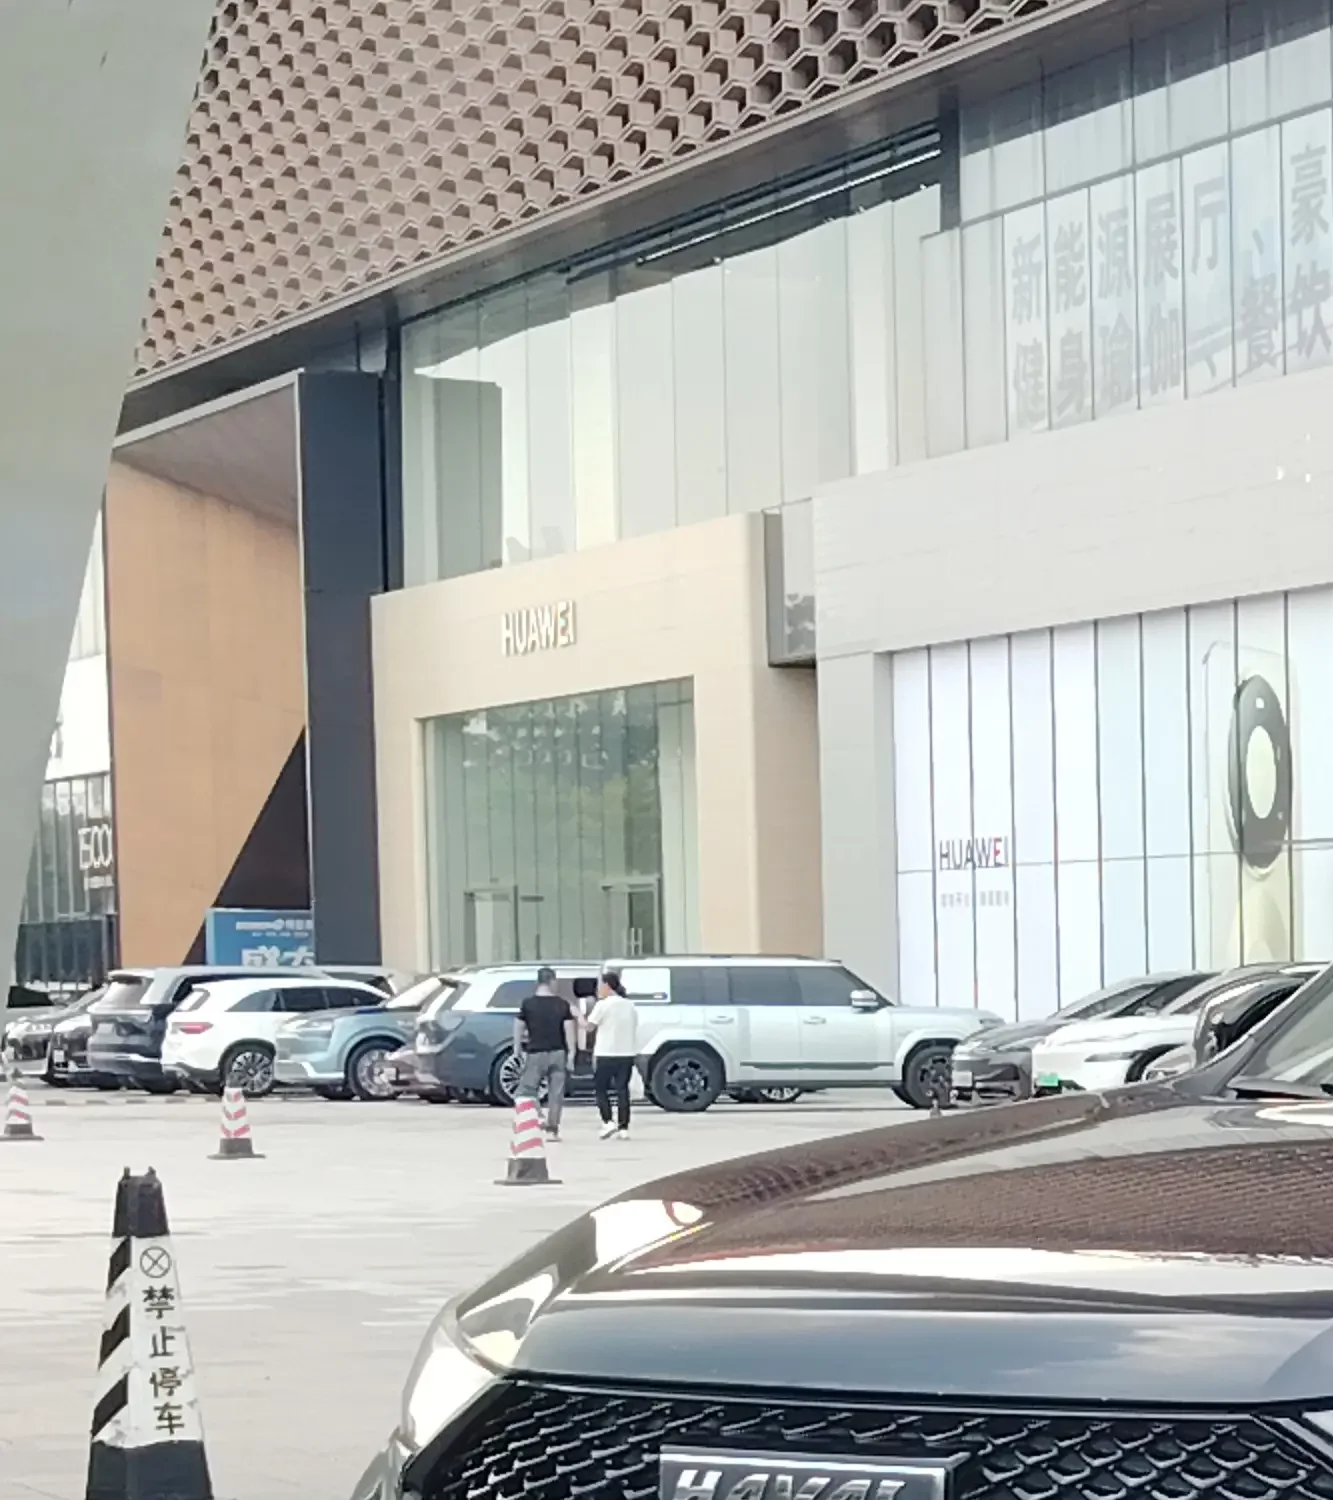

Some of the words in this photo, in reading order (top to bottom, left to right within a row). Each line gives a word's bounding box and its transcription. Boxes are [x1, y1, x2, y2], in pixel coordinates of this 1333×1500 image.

[501, 599, 577, 657] HUAWEI
[939, 835, 1009, 871] HUAWEI
[142, 1285, 185, 1435] 禁止停车
